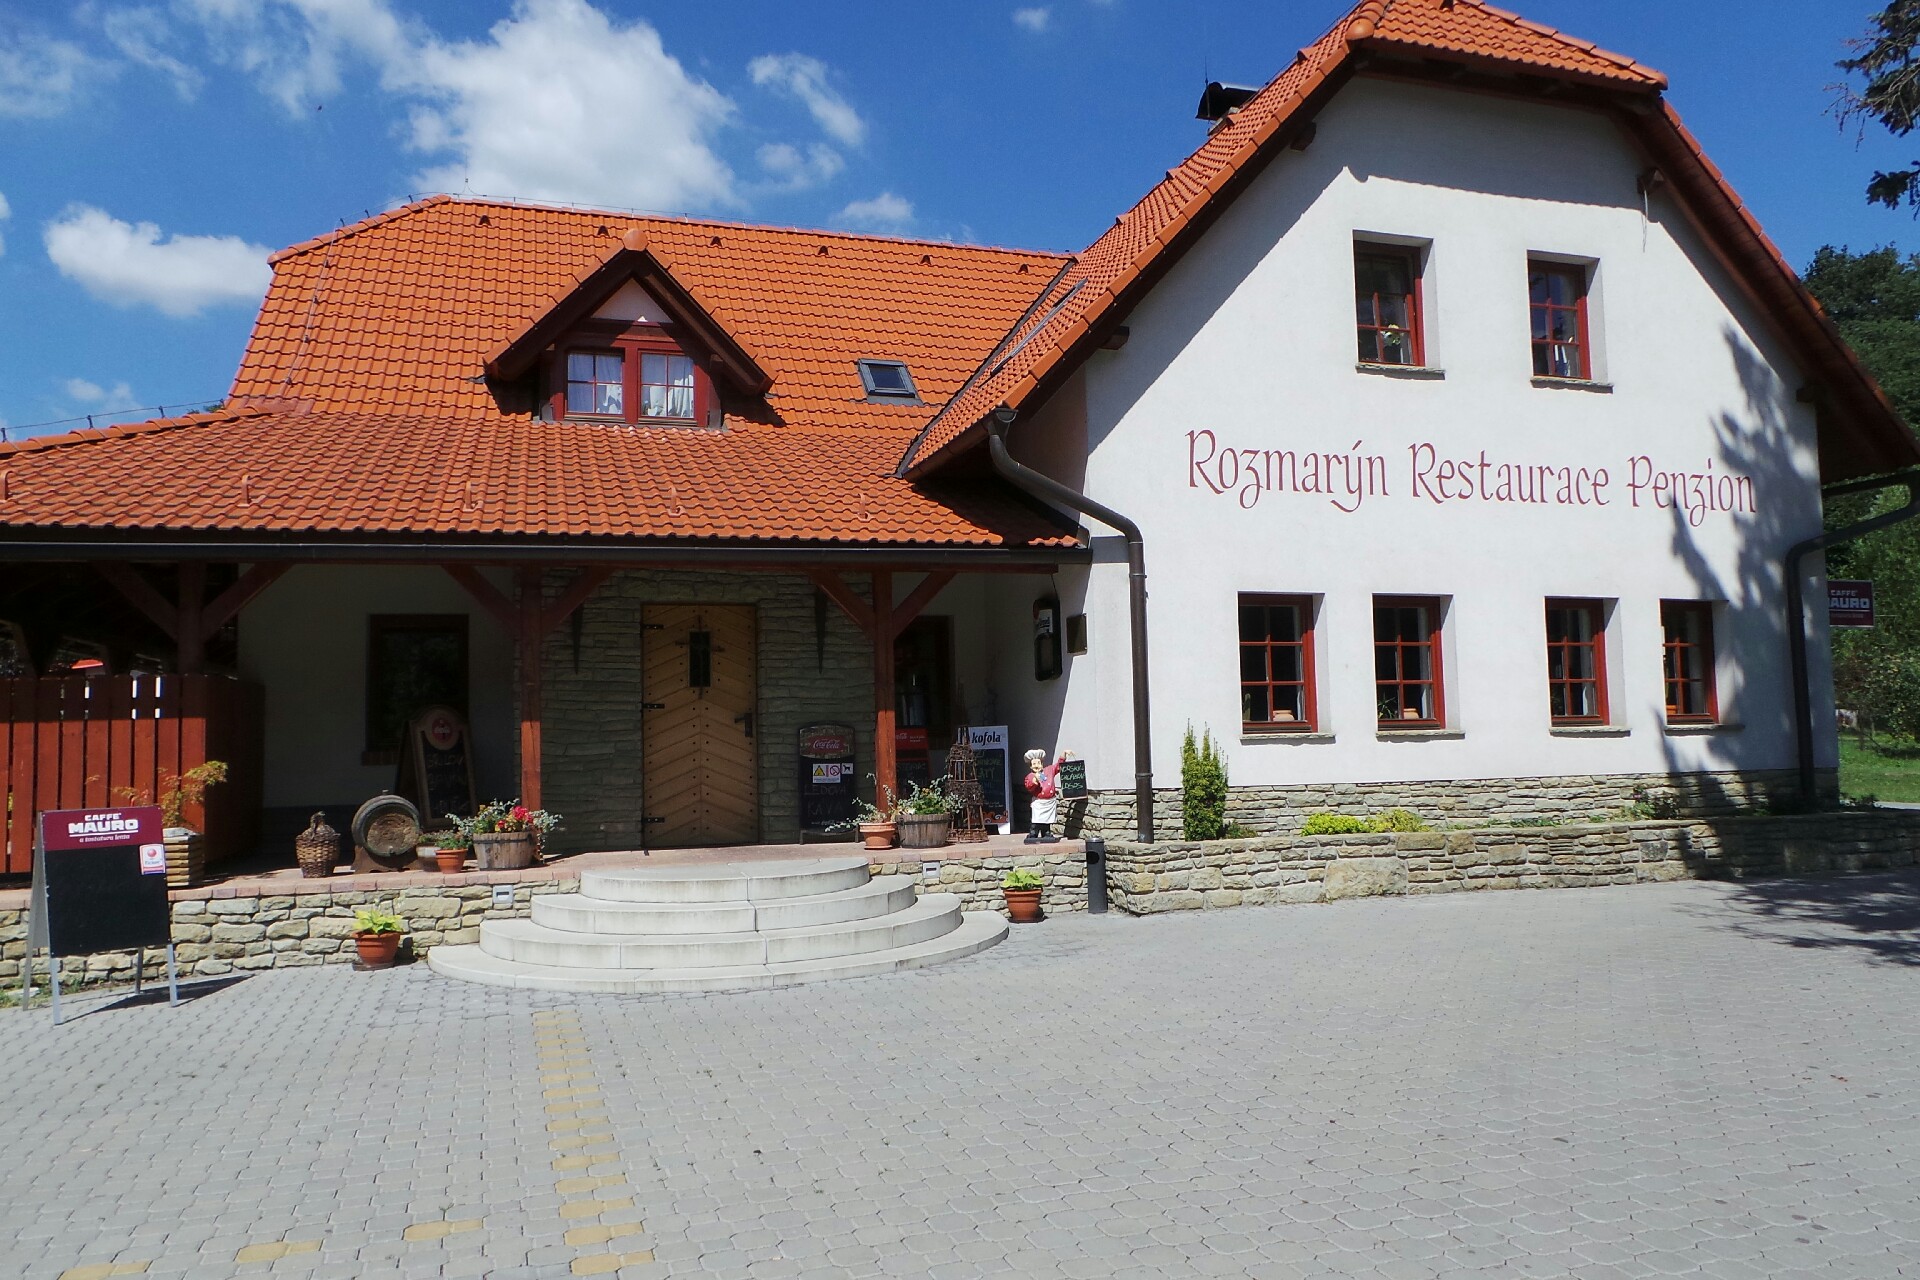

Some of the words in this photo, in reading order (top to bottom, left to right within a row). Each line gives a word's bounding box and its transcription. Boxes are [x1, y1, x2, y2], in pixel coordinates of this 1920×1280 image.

[1184, 429, 1391, 513] Rozmarýn
[1407, 442, 1610, 505] Restaurace
[1626, 455, 1757, 527] Penzion
[1829, 597, 1870, 609] AURO
[971, 731, 1001, 746] kofola
[68, 819, 139, 834] MAURO
